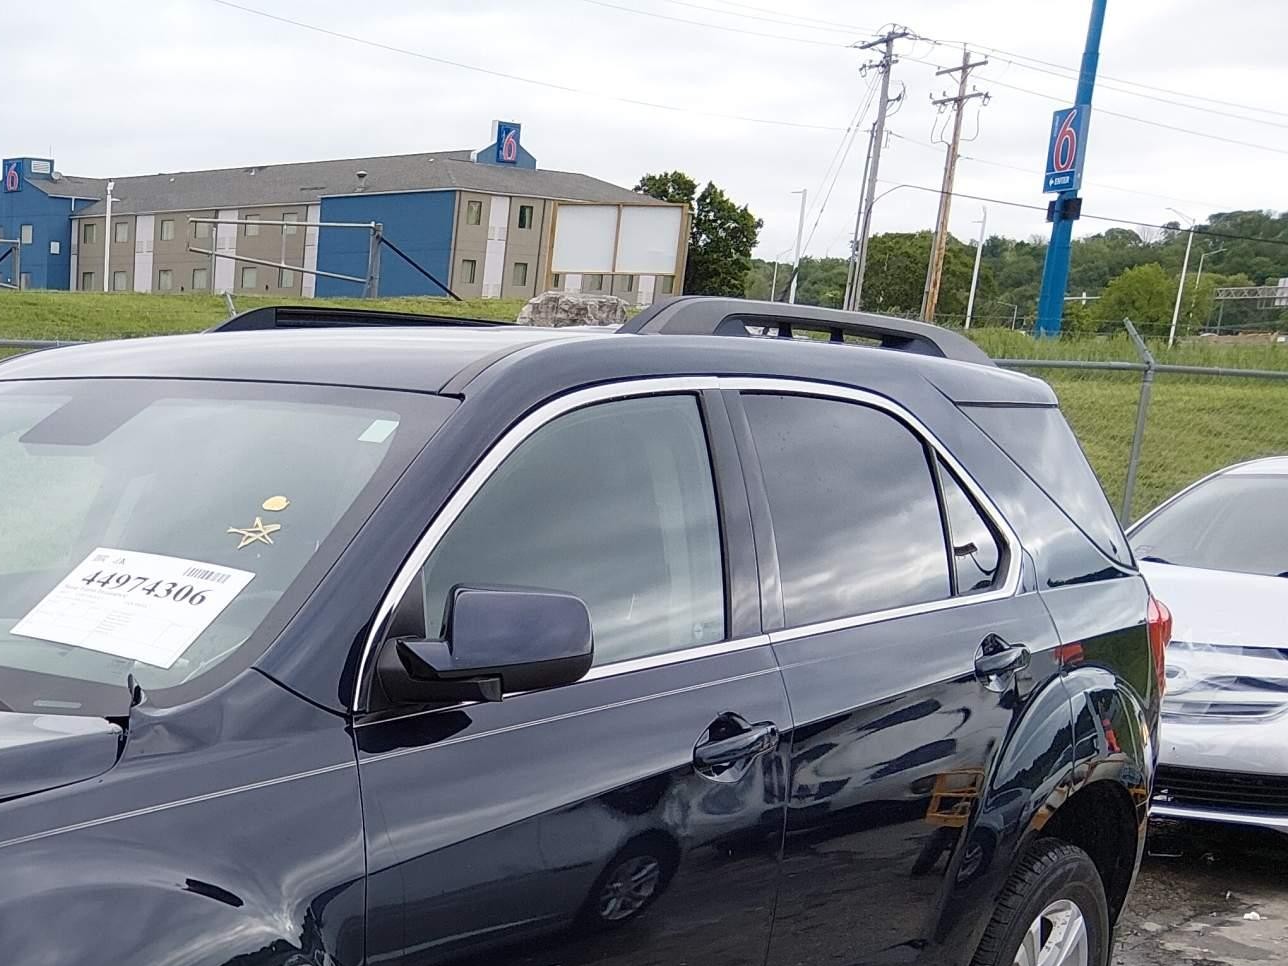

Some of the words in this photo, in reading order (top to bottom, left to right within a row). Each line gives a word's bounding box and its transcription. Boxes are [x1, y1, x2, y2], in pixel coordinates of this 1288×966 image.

[503, 129, 517, 161] 6
[1053, 109, 1077, 172] 6
[6, 162, 19, 192] 6
[81, 569, 213, 606] 44974306
